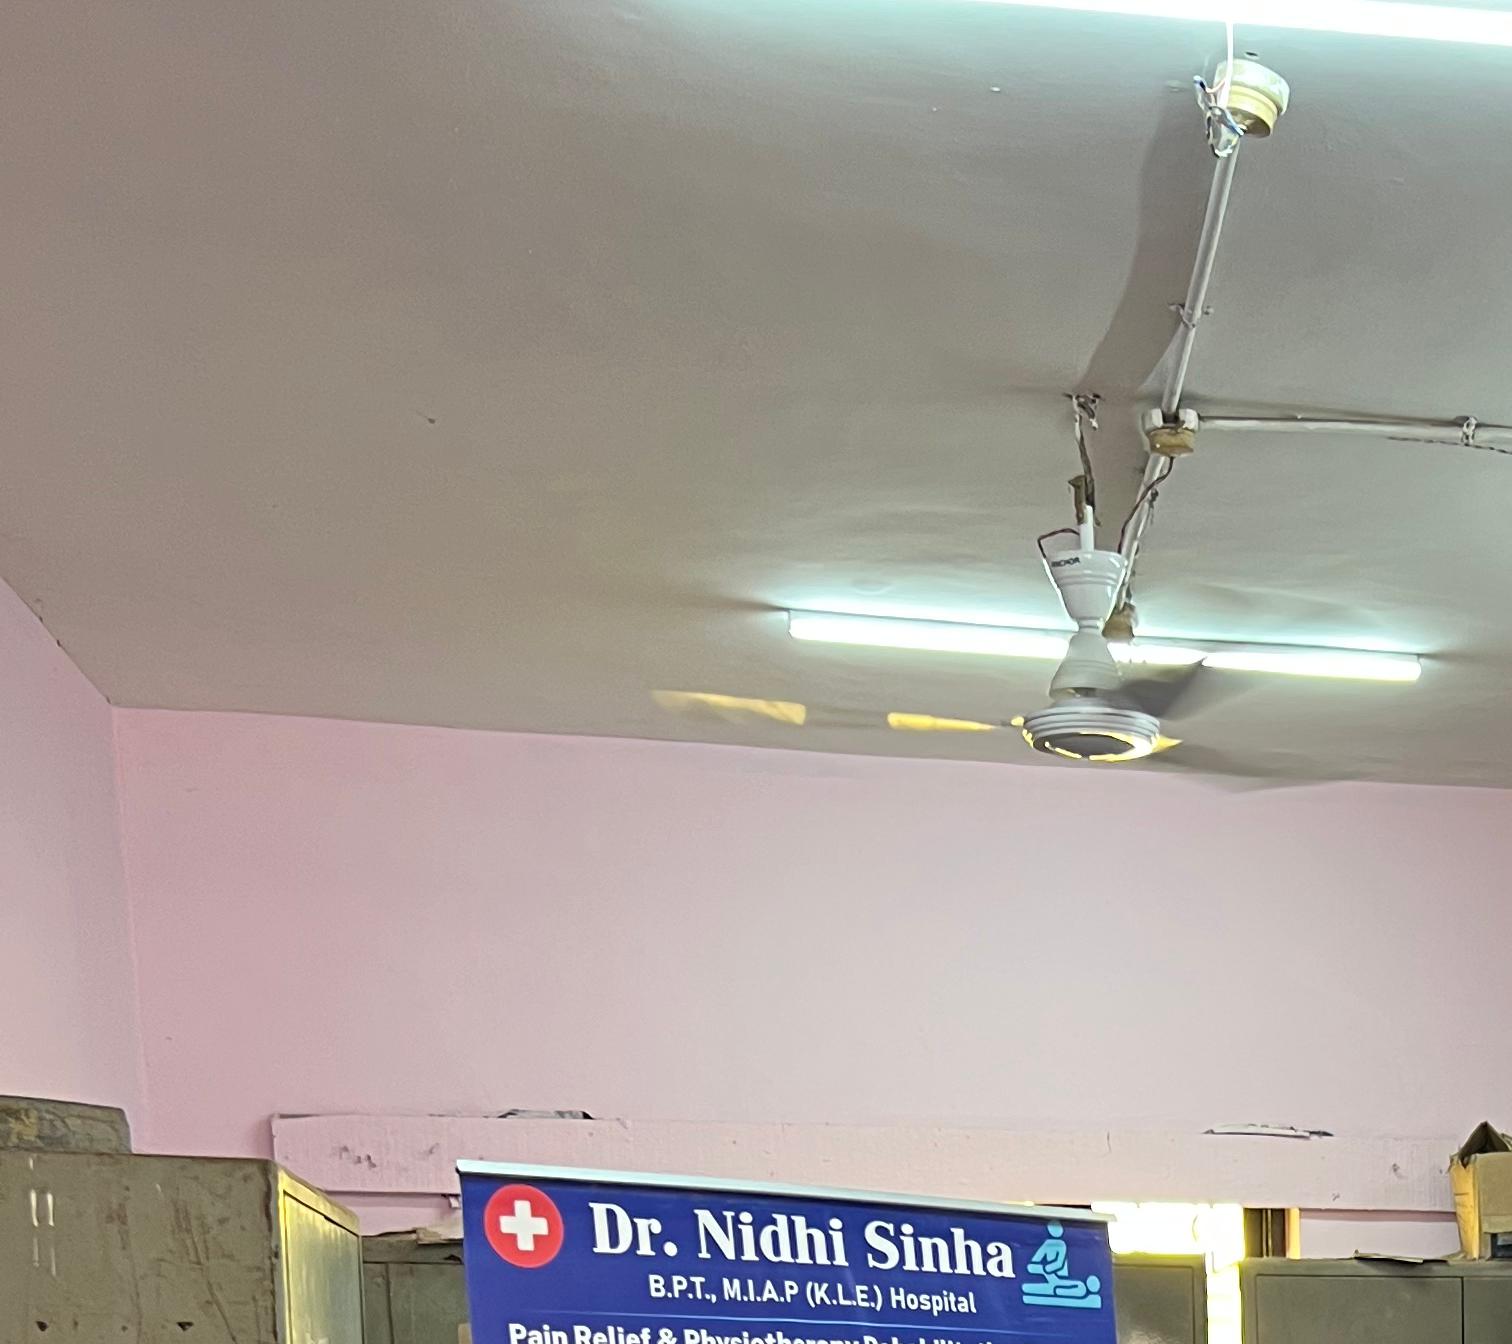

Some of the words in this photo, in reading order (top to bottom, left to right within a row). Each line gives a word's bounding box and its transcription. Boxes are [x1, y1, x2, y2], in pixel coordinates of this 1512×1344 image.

[589, 1203, 677, 1256] Dr.
[694, 1210, 849, 1266] Nidhi
[865, 1221, 1016, 1278] Sinha
[649, 1275, 716, 1303] B.P.T.,
[723, 1278, 798, 1302] M.I.A.P
[807, 1282, 882, 1311] (K.L.E.)
[890, 1287, 976, 1316] Hospital
